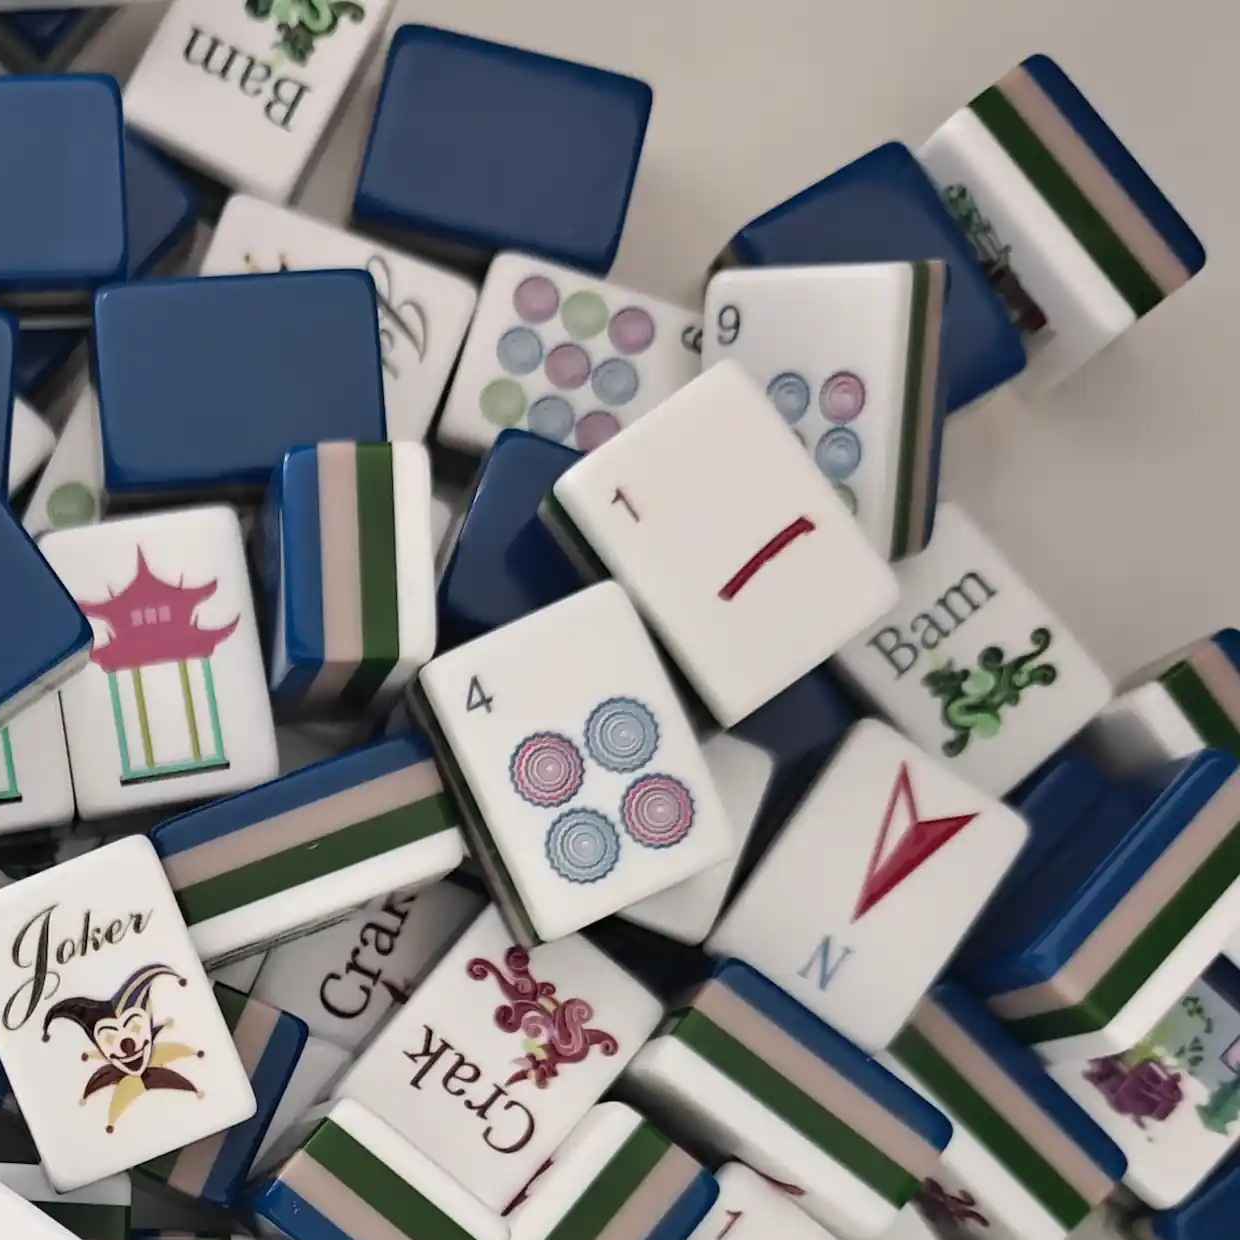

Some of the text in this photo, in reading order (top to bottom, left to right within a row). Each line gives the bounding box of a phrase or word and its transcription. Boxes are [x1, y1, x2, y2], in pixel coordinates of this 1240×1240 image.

[182, 27, 312, 131] Bam
[718, 304, 740, 346] 9
[611, 488, 640, 524] 1
[866, 568, 999, 679] Bam
[466, 675, 493, 713] 4
[2, 903, 154, 1032] Joker
[797, 935, 856, 991] N
[403, 1024, 535, 1154] Crak
